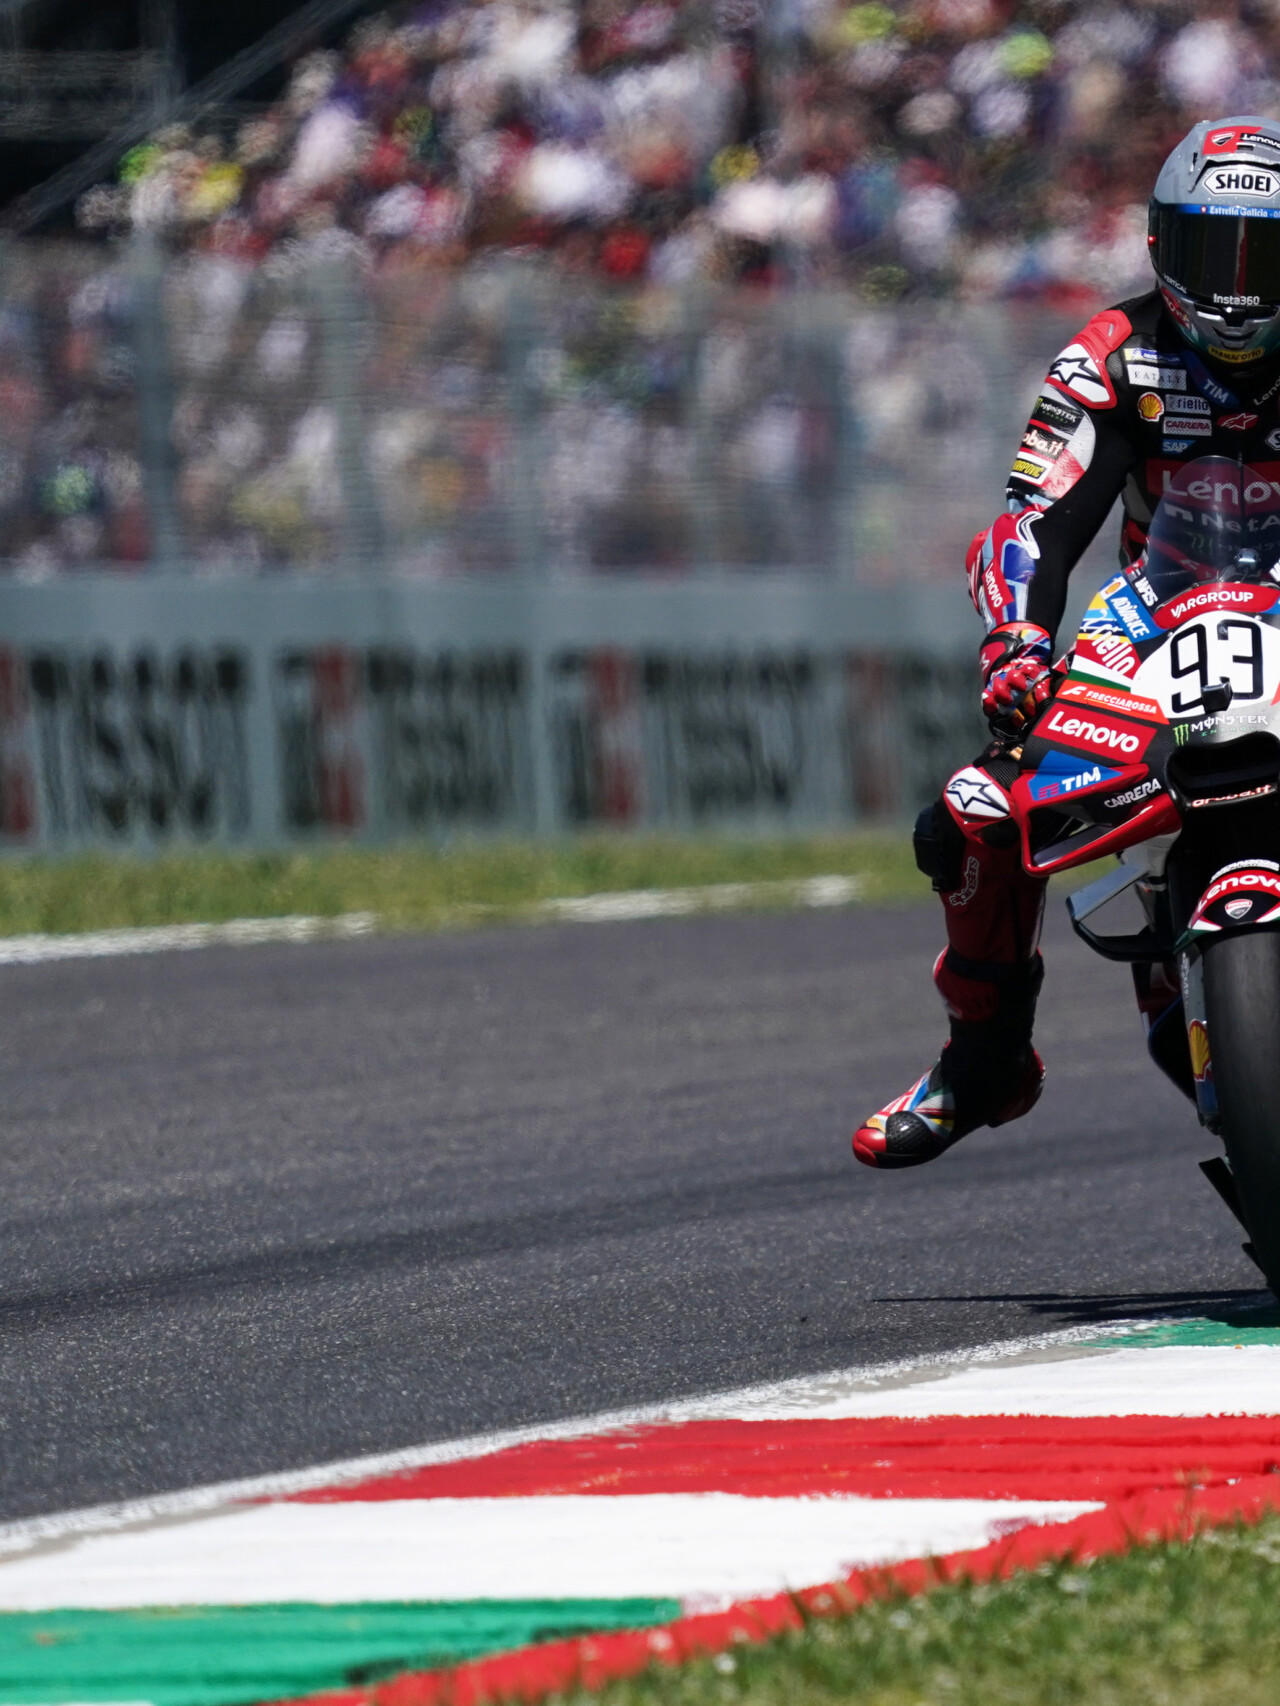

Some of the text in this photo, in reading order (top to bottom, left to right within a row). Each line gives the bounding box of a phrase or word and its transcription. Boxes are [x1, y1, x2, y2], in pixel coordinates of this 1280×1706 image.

[1215, 174, 1271, 192] SHOEI
[1209, 205, 1239, 216] Estrella
[1240, 206, 1268, 218] Galicia
[1163, 273, 1188, 294] VERTICAL
[1213, 293, 1260, 306] Insta360
[1203, 379, 1229, 403] TIM
[1041, 402, 1077, 422] MONSTER
[1176, 399, 1209, 411] riello
[1165, 420, 1211, 431] CARRERA
[1162, 441, 1187, 453] SAP
[986, 562, 1003, 608] Lenovo
[1134, 576, 1158, 607] WRS
[1110, 597, 1150, 639] ADVANCE
[1170, 619, 1264, 714] 93
[1086, 690, 1157, 714] FRECCIAROSSA
[1047, 711, 1139, 752] Lenovo
[1191, 715, 1269, 732] MONSTER
[1062, 767, 1101, 792] TIM
[1104, 778, 1162, 808] CARRERA
